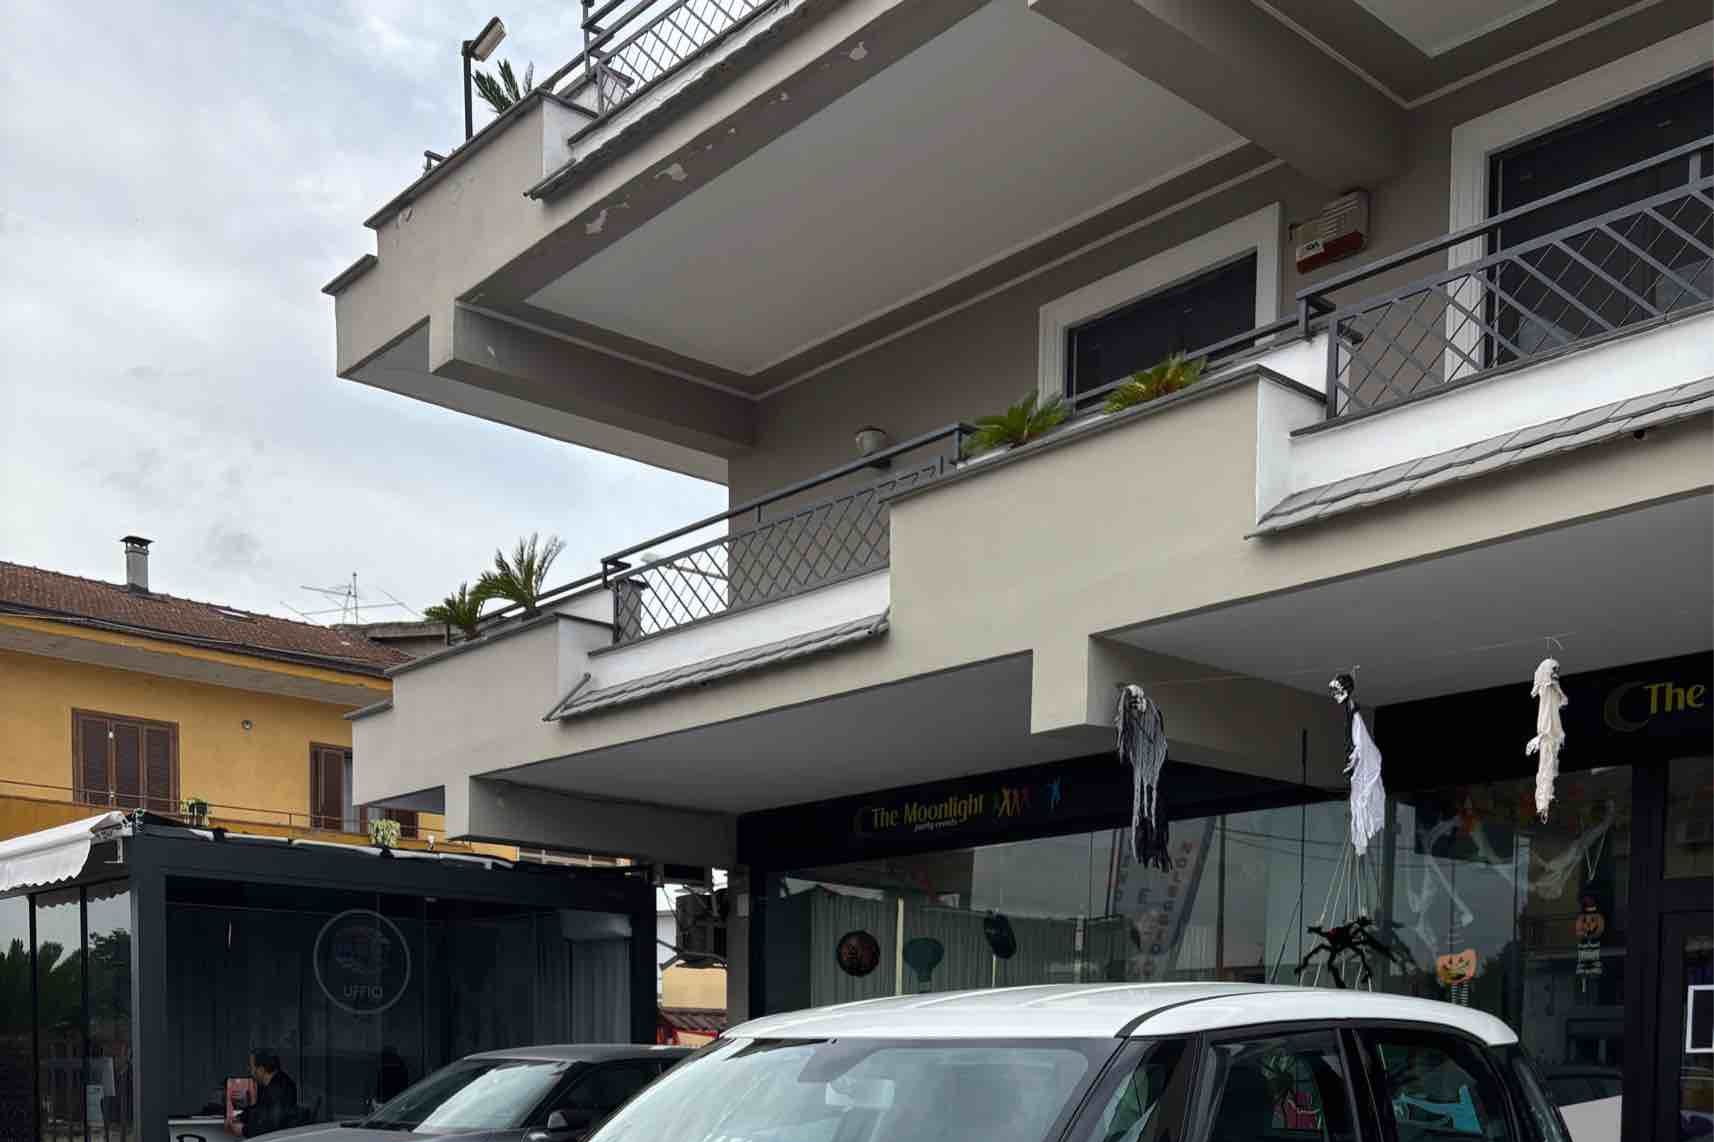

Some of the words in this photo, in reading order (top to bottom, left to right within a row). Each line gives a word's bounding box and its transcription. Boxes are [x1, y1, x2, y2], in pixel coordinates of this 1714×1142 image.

[1644, 681, 1706, 714] The
[871, 807, 898, 830] The
[903, 792, 985, 824] Moonlight
